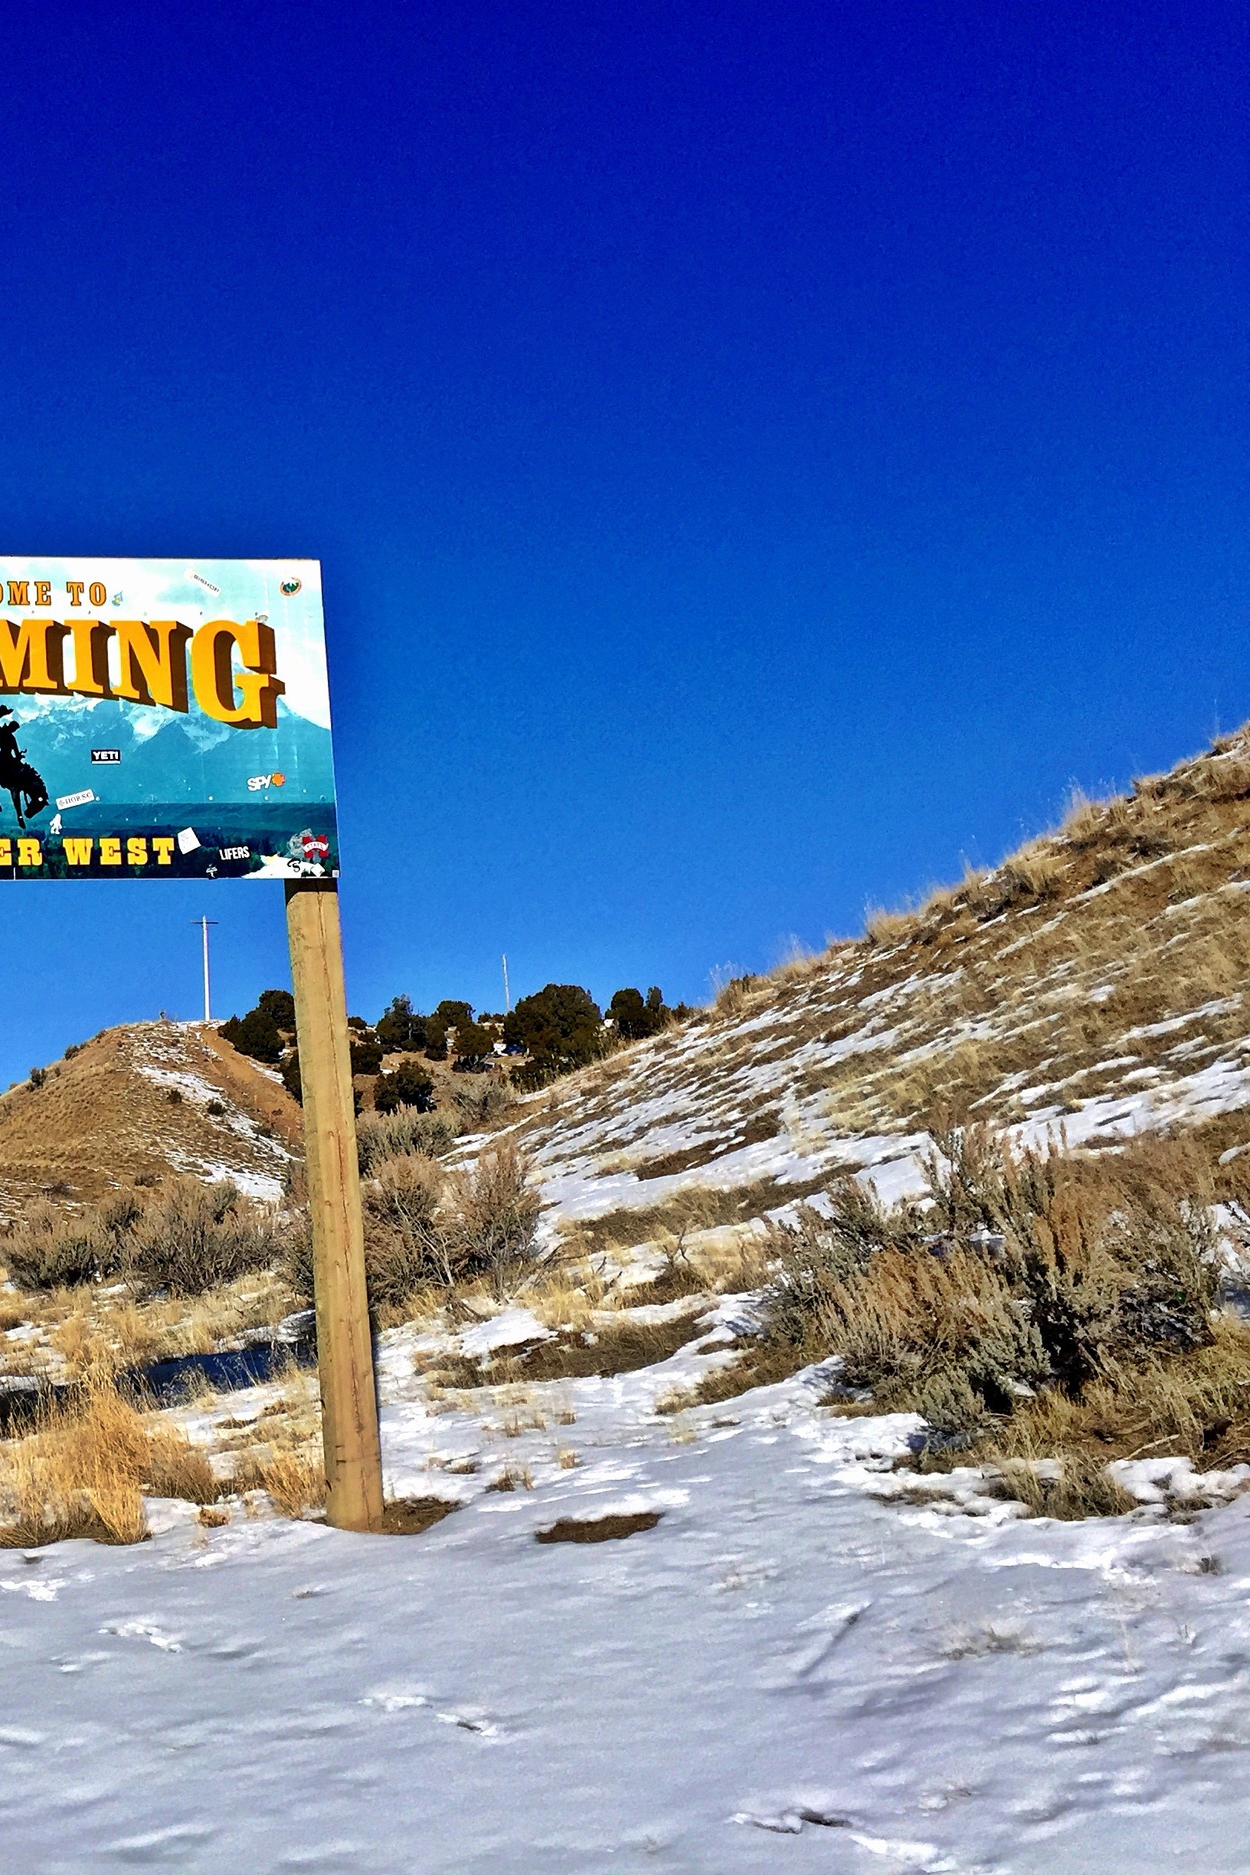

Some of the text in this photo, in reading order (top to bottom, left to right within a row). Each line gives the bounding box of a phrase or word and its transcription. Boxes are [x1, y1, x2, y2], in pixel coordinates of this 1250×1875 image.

[66, 581, 107, 606] TO
[93, 751, 119, 760] YETI
[247, 774, 271, 791] SPY
[62, 837, 175, 866] WEST
[219, 846, 250, 860] LIFERS
